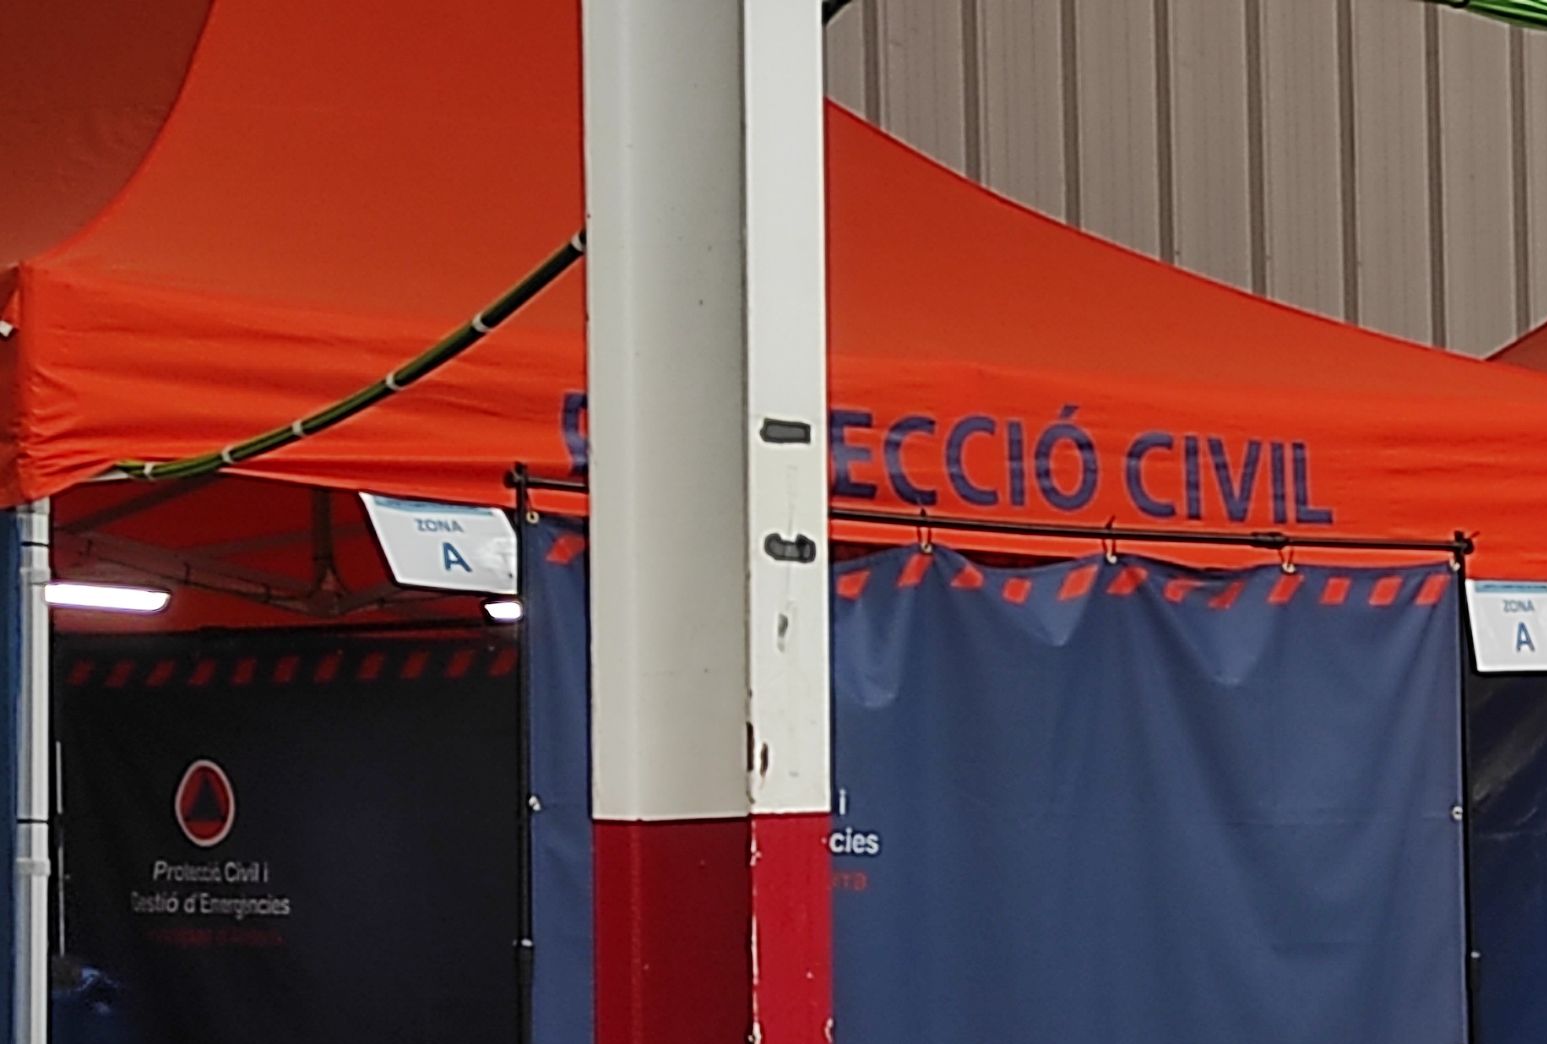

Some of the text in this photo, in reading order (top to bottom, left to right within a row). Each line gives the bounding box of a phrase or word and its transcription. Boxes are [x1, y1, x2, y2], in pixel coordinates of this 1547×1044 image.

[1125, 433, 1333, 524] CIVIL
[415, 518, 463, 532] ZONA
[441, 542, 472, 572] A
[1503, 600, 1535, 612] ZONA
[1516, 622, 1535, 652] A
